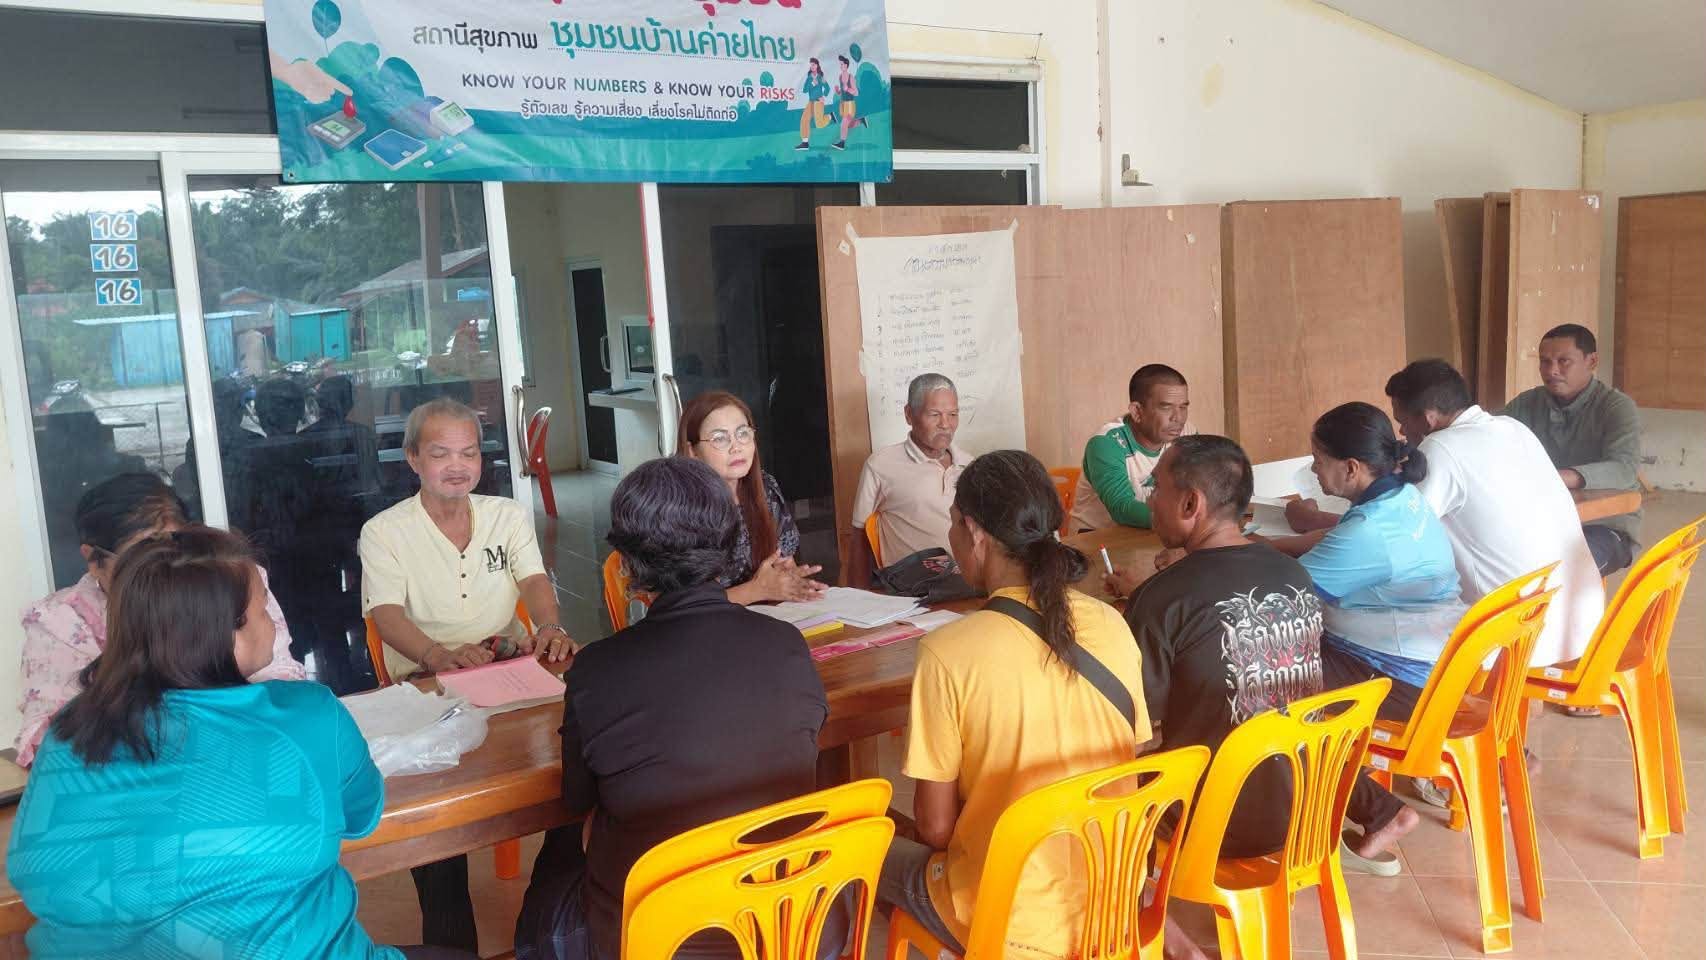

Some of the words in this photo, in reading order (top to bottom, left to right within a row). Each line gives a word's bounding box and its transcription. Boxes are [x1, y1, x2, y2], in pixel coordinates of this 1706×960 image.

[413, 22, 538, 53] สถานีสุขภาพ
[550, 18, 795, 61] ชุมชนบ้านค่ายไทย
[462, 73, 514, 89] KNOW
[522, 75, 566, 91] YOUR
[574, 78, 647, 94] NUMBERS
[653, 81, 664, 95] &
[669, 82, 712, 97] KNOW
[718, 85, 754, 99] YOUR
[760, 87, 795, 100] RISKS
[521, 99, 568, 118] รู้ตัวเลข
[574, 100, 642, 119] รู้ความเสี่ยง
[649, 101, 737, 121] เลี่ยงโรคไม่ติดต่อ
[94, 214, 132, 239] 16
[94, 245, 133, 270] 16
[99, 279, 138, 305] 16
